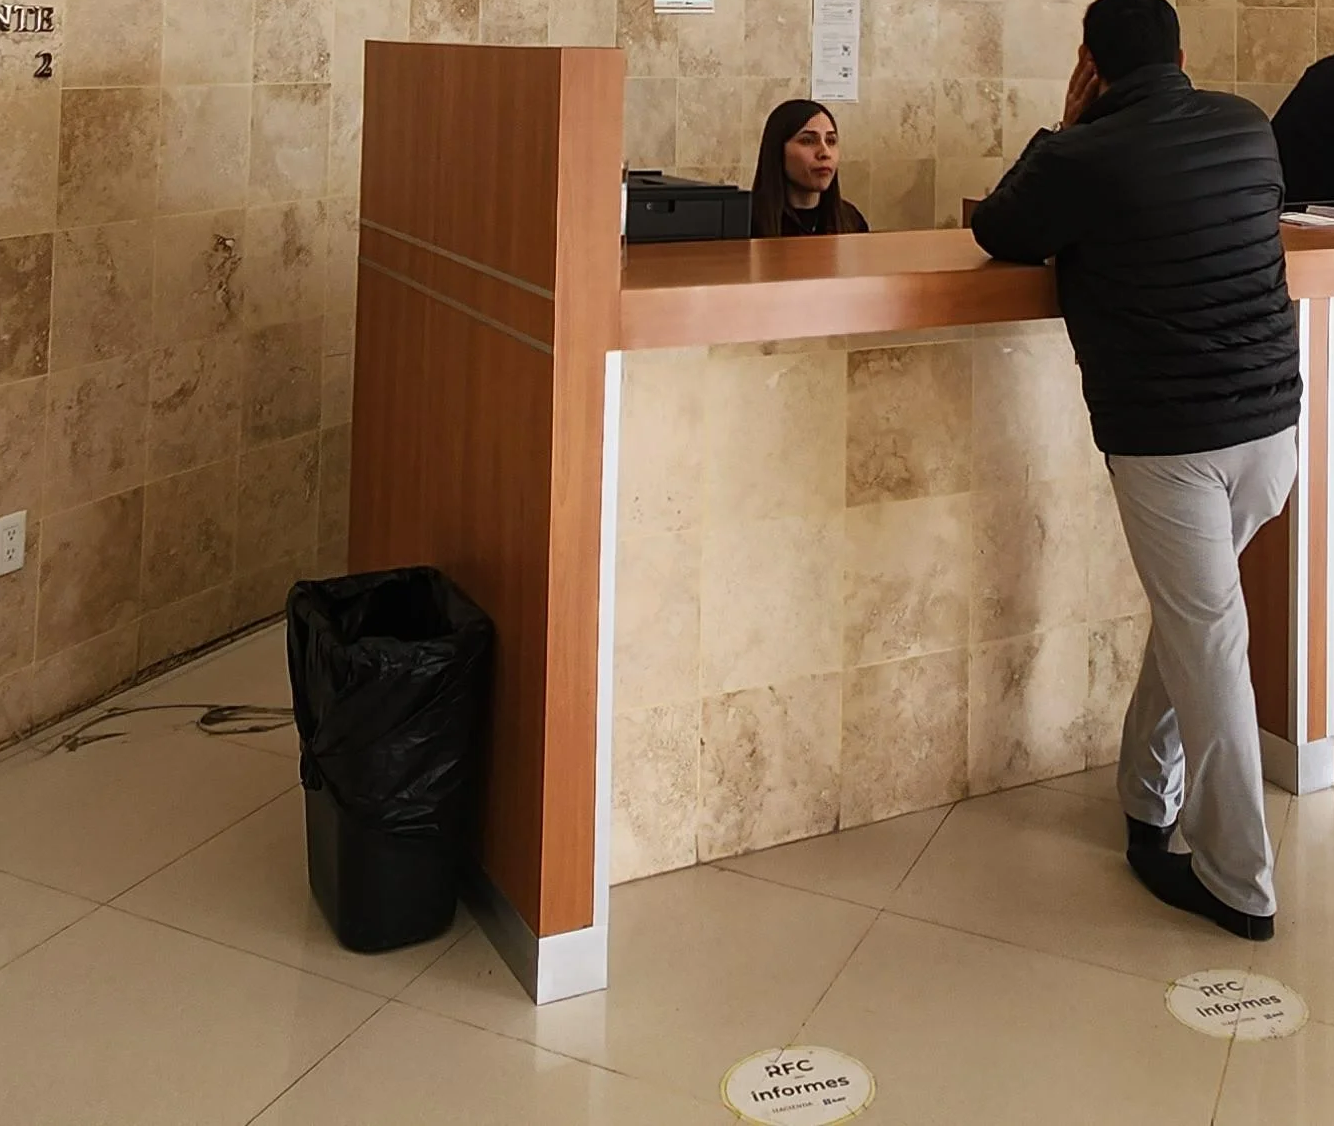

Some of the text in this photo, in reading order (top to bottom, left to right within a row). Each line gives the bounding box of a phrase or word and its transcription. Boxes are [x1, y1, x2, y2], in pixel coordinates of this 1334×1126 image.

[33, 52, 54, 79] 2
[1198, 980, 1245, 997] RFC
[764, 1059, 815, 1078] RFC
